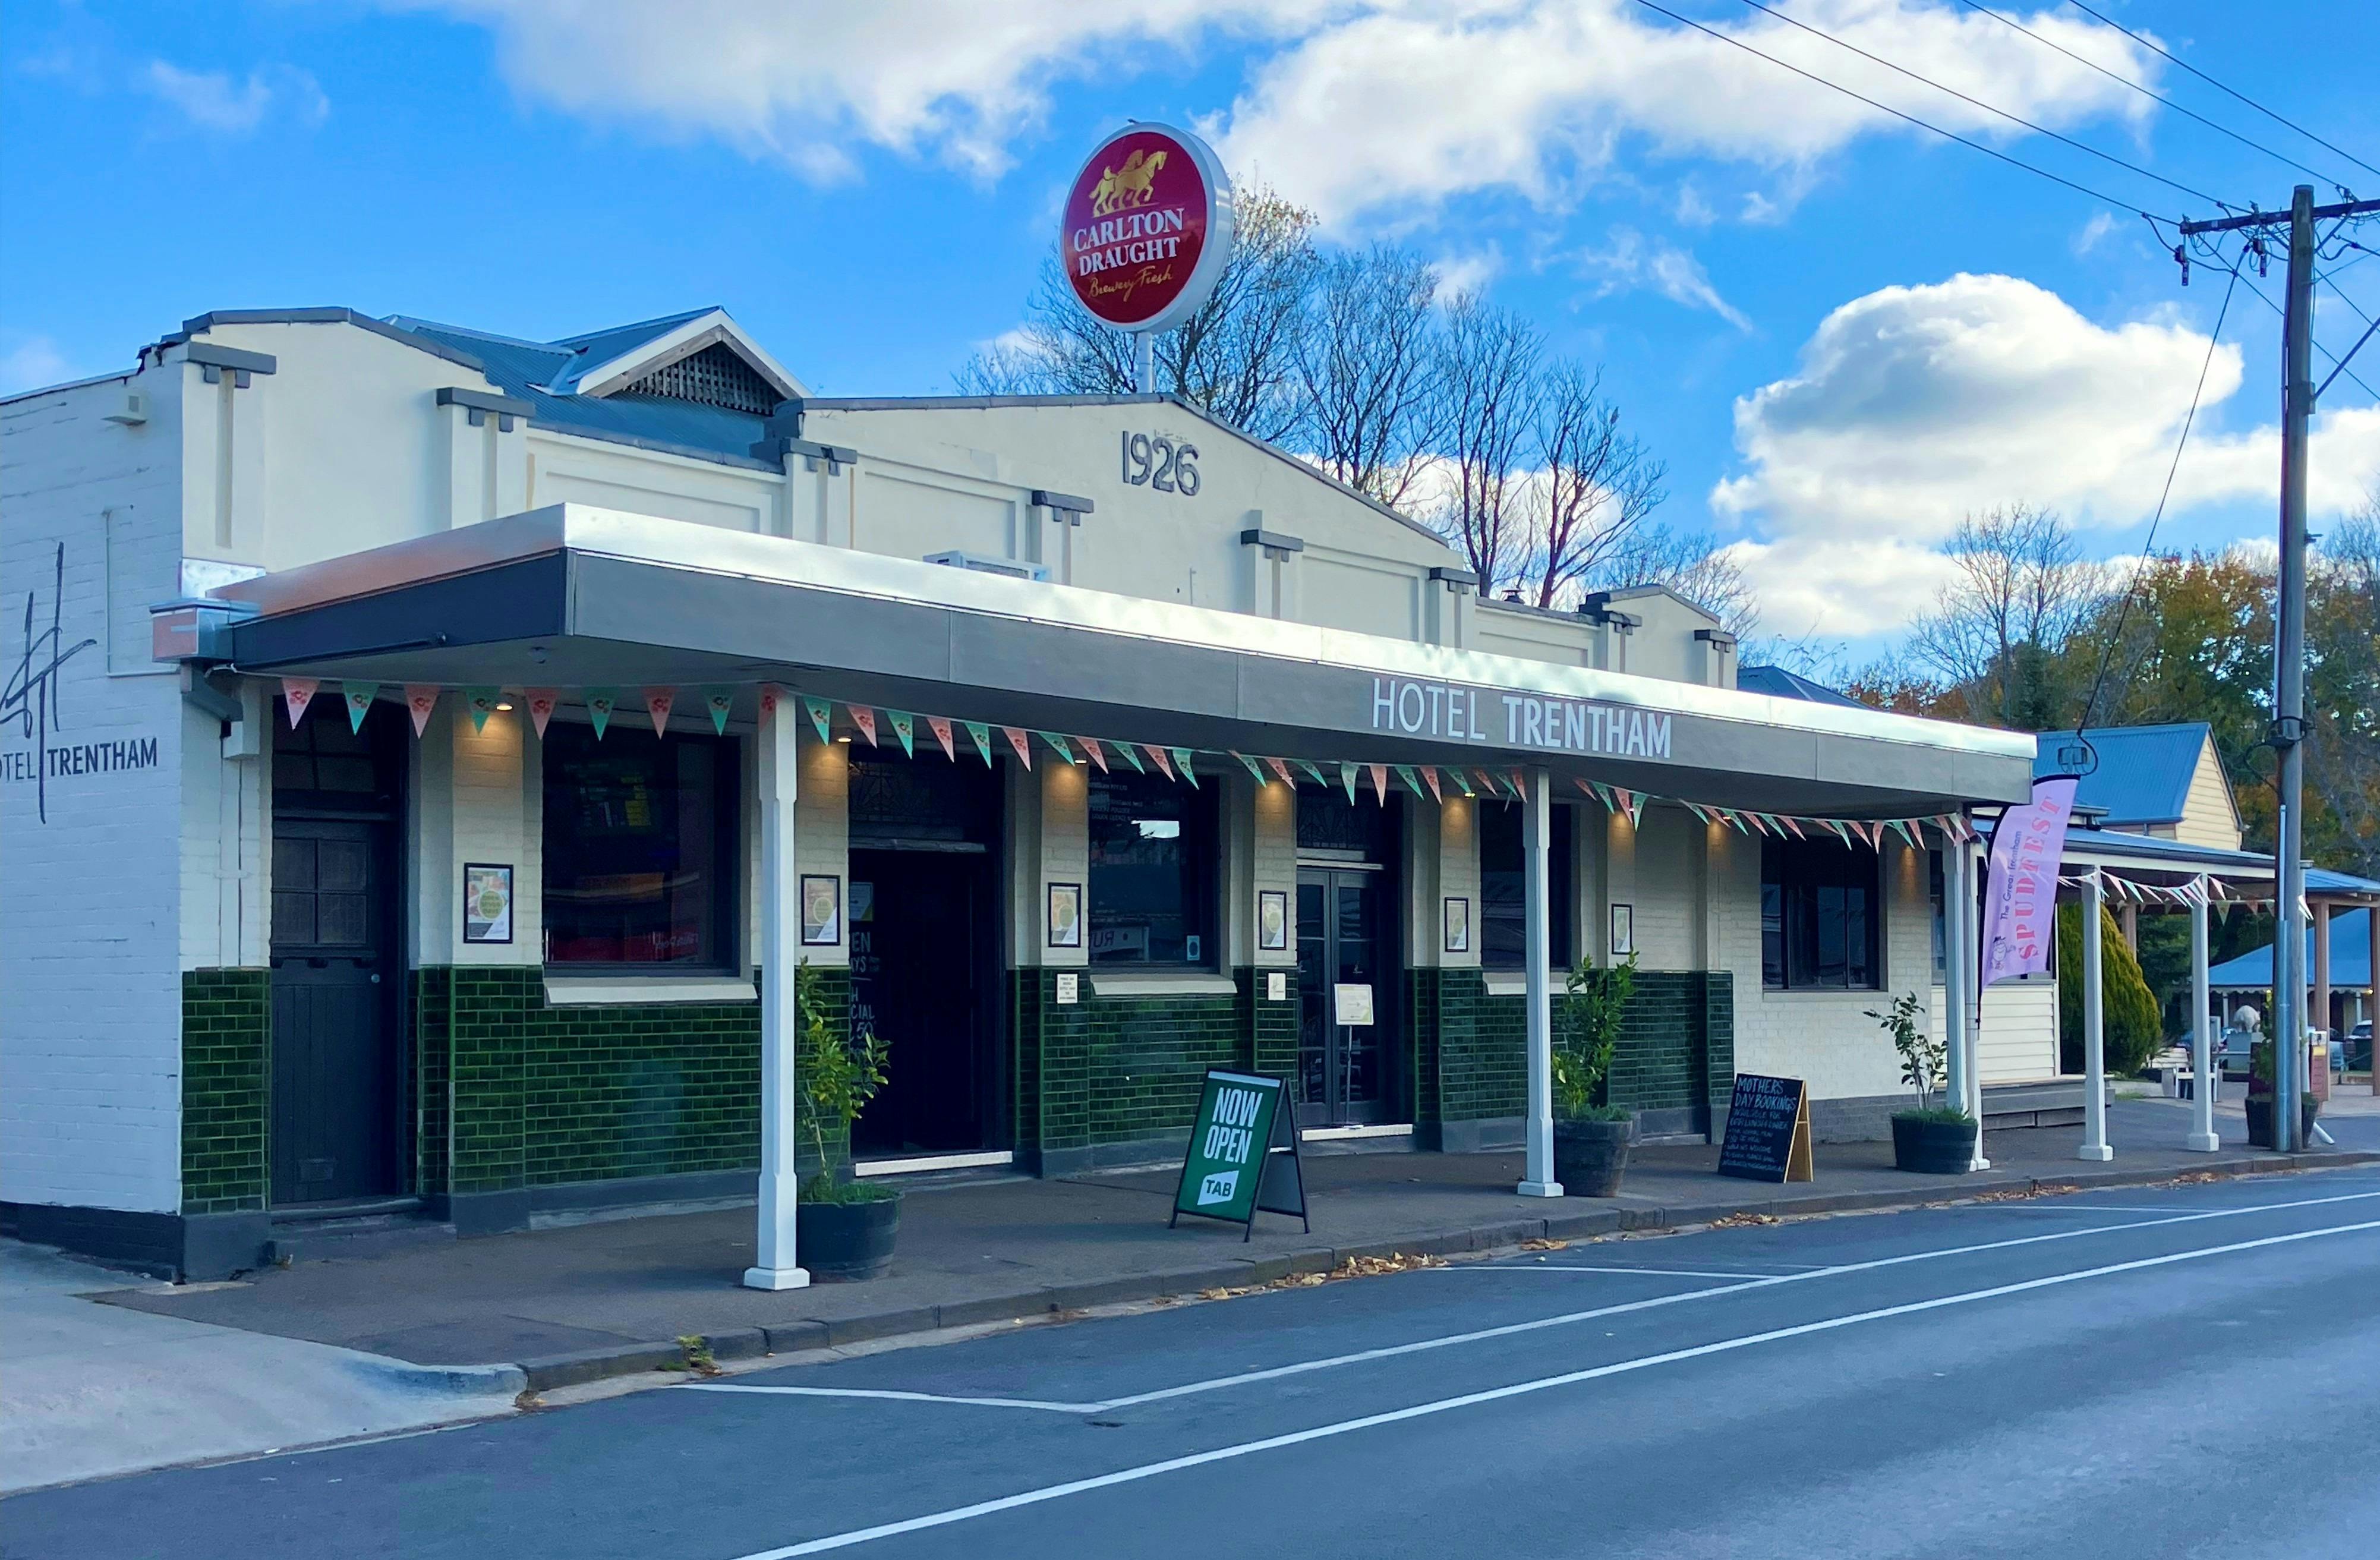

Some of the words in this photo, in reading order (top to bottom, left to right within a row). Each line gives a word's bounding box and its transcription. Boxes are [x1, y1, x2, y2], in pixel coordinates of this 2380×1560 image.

[1074, 208, 1184, 252] CARLTON
[1079, 237, 1180, 276] DRAUGHT
[1089, 277, 1137, 302] Brewery
[1135, 264, 1173, 288] Fresh
[1123, 430, 1200, 496] 1926
[1372, 677, 1486, 740] HOTEL
[1502, 695, 1671, 759] TRENTHAM
[0, 751, 36, 781] TEL
[47, 737, 157, 777] TRENTHAM
[2015, 795, 2060, 960] SPUDFEST
[2000, 905, 2010, 920] The
[851, 931, 871, 953] EN
[1735, 1093, 1755, 1108] DAY
[1754, 1094, 1796, 1114] BOOKINGS
[1736, 1076, 1783, 1095] MOTHERS
[1212, 1087, 1263, 1127] NOW
[1203, 1125, 1253, 1164] OPEN
[1206, 1179, 1232, 1197] TAB
